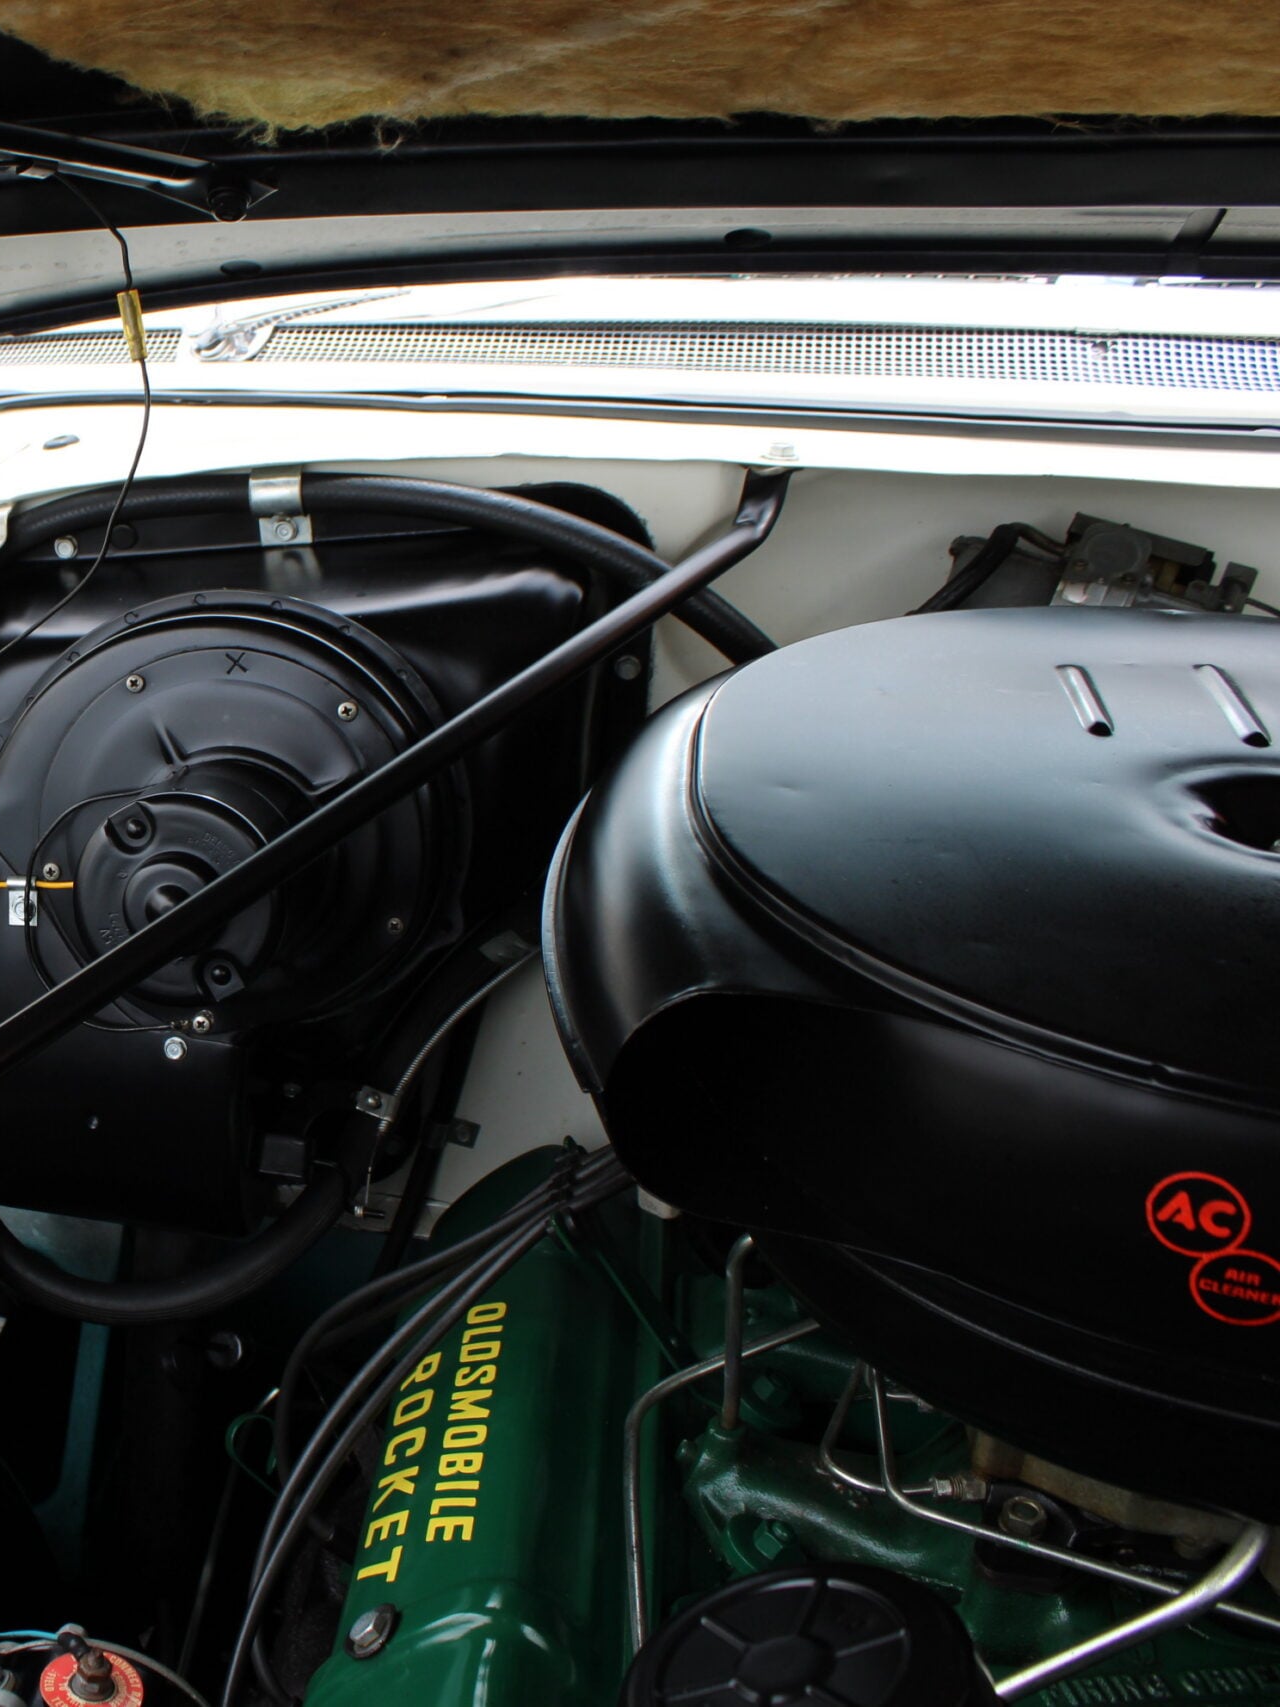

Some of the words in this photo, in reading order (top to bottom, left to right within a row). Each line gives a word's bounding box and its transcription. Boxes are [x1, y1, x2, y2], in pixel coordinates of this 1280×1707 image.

[1156, 1190, 1237, 1239] AC
[1224, 1267, 1262, 1286] AIR
[357, 1351, 442, 1583] ROCKET
[425, 1302, 508, 1543] OLDSMOBILE
